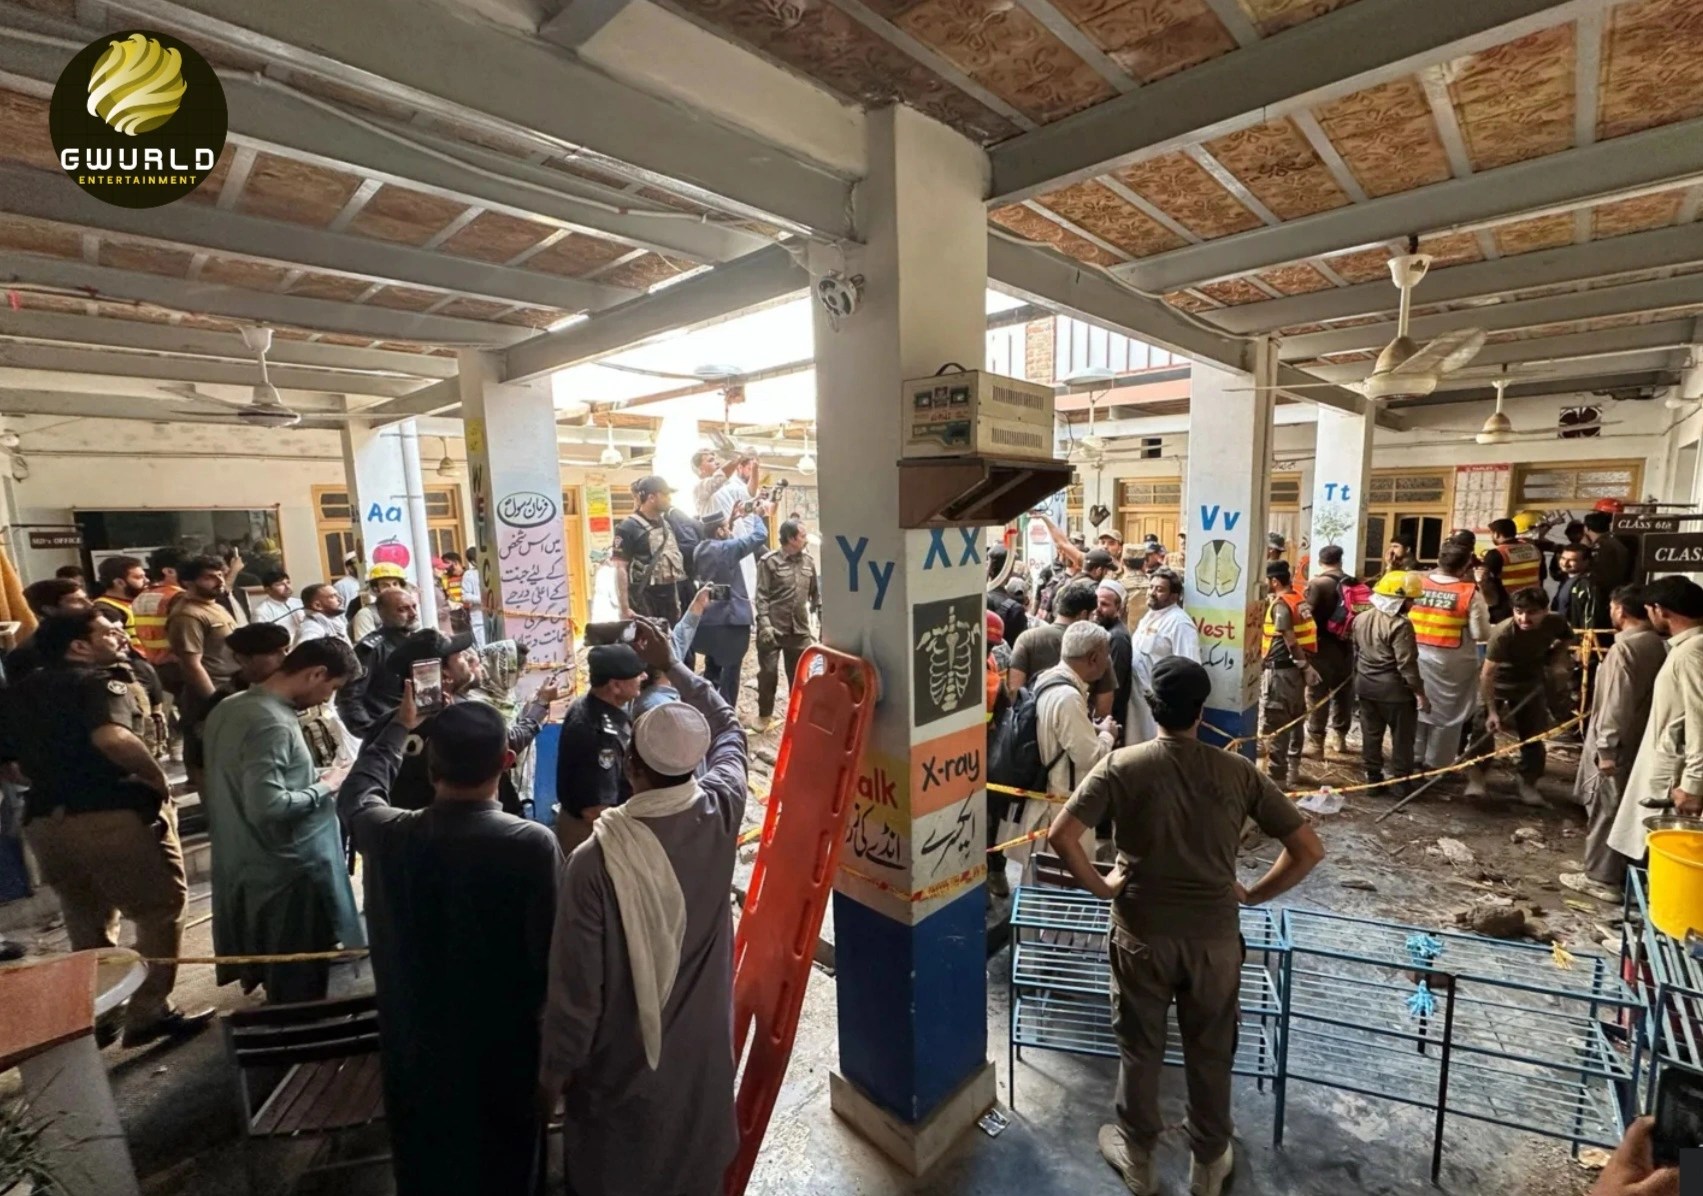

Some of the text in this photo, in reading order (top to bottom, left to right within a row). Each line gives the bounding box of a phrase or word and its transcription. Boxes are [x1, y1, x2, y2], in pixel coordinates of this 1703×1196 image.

[367, 502, 402, 523] Aa
[1200, 505, 1241, 531] Vv
[1618, 519, 1672, 529] CLASS 6th
[499, 530, 561, 560] میں اس شخص
[1654, 547, 1703, 562] CLAS
[501, 566, 529, 584] جنت
[546, 556, 564, 580] کے
[549, 581, 568, 600] کے
[1201, 640, 1234, 671] واسک
[921, 749, 980, 793] X-ray
[857, 767, 898, 810] alk
